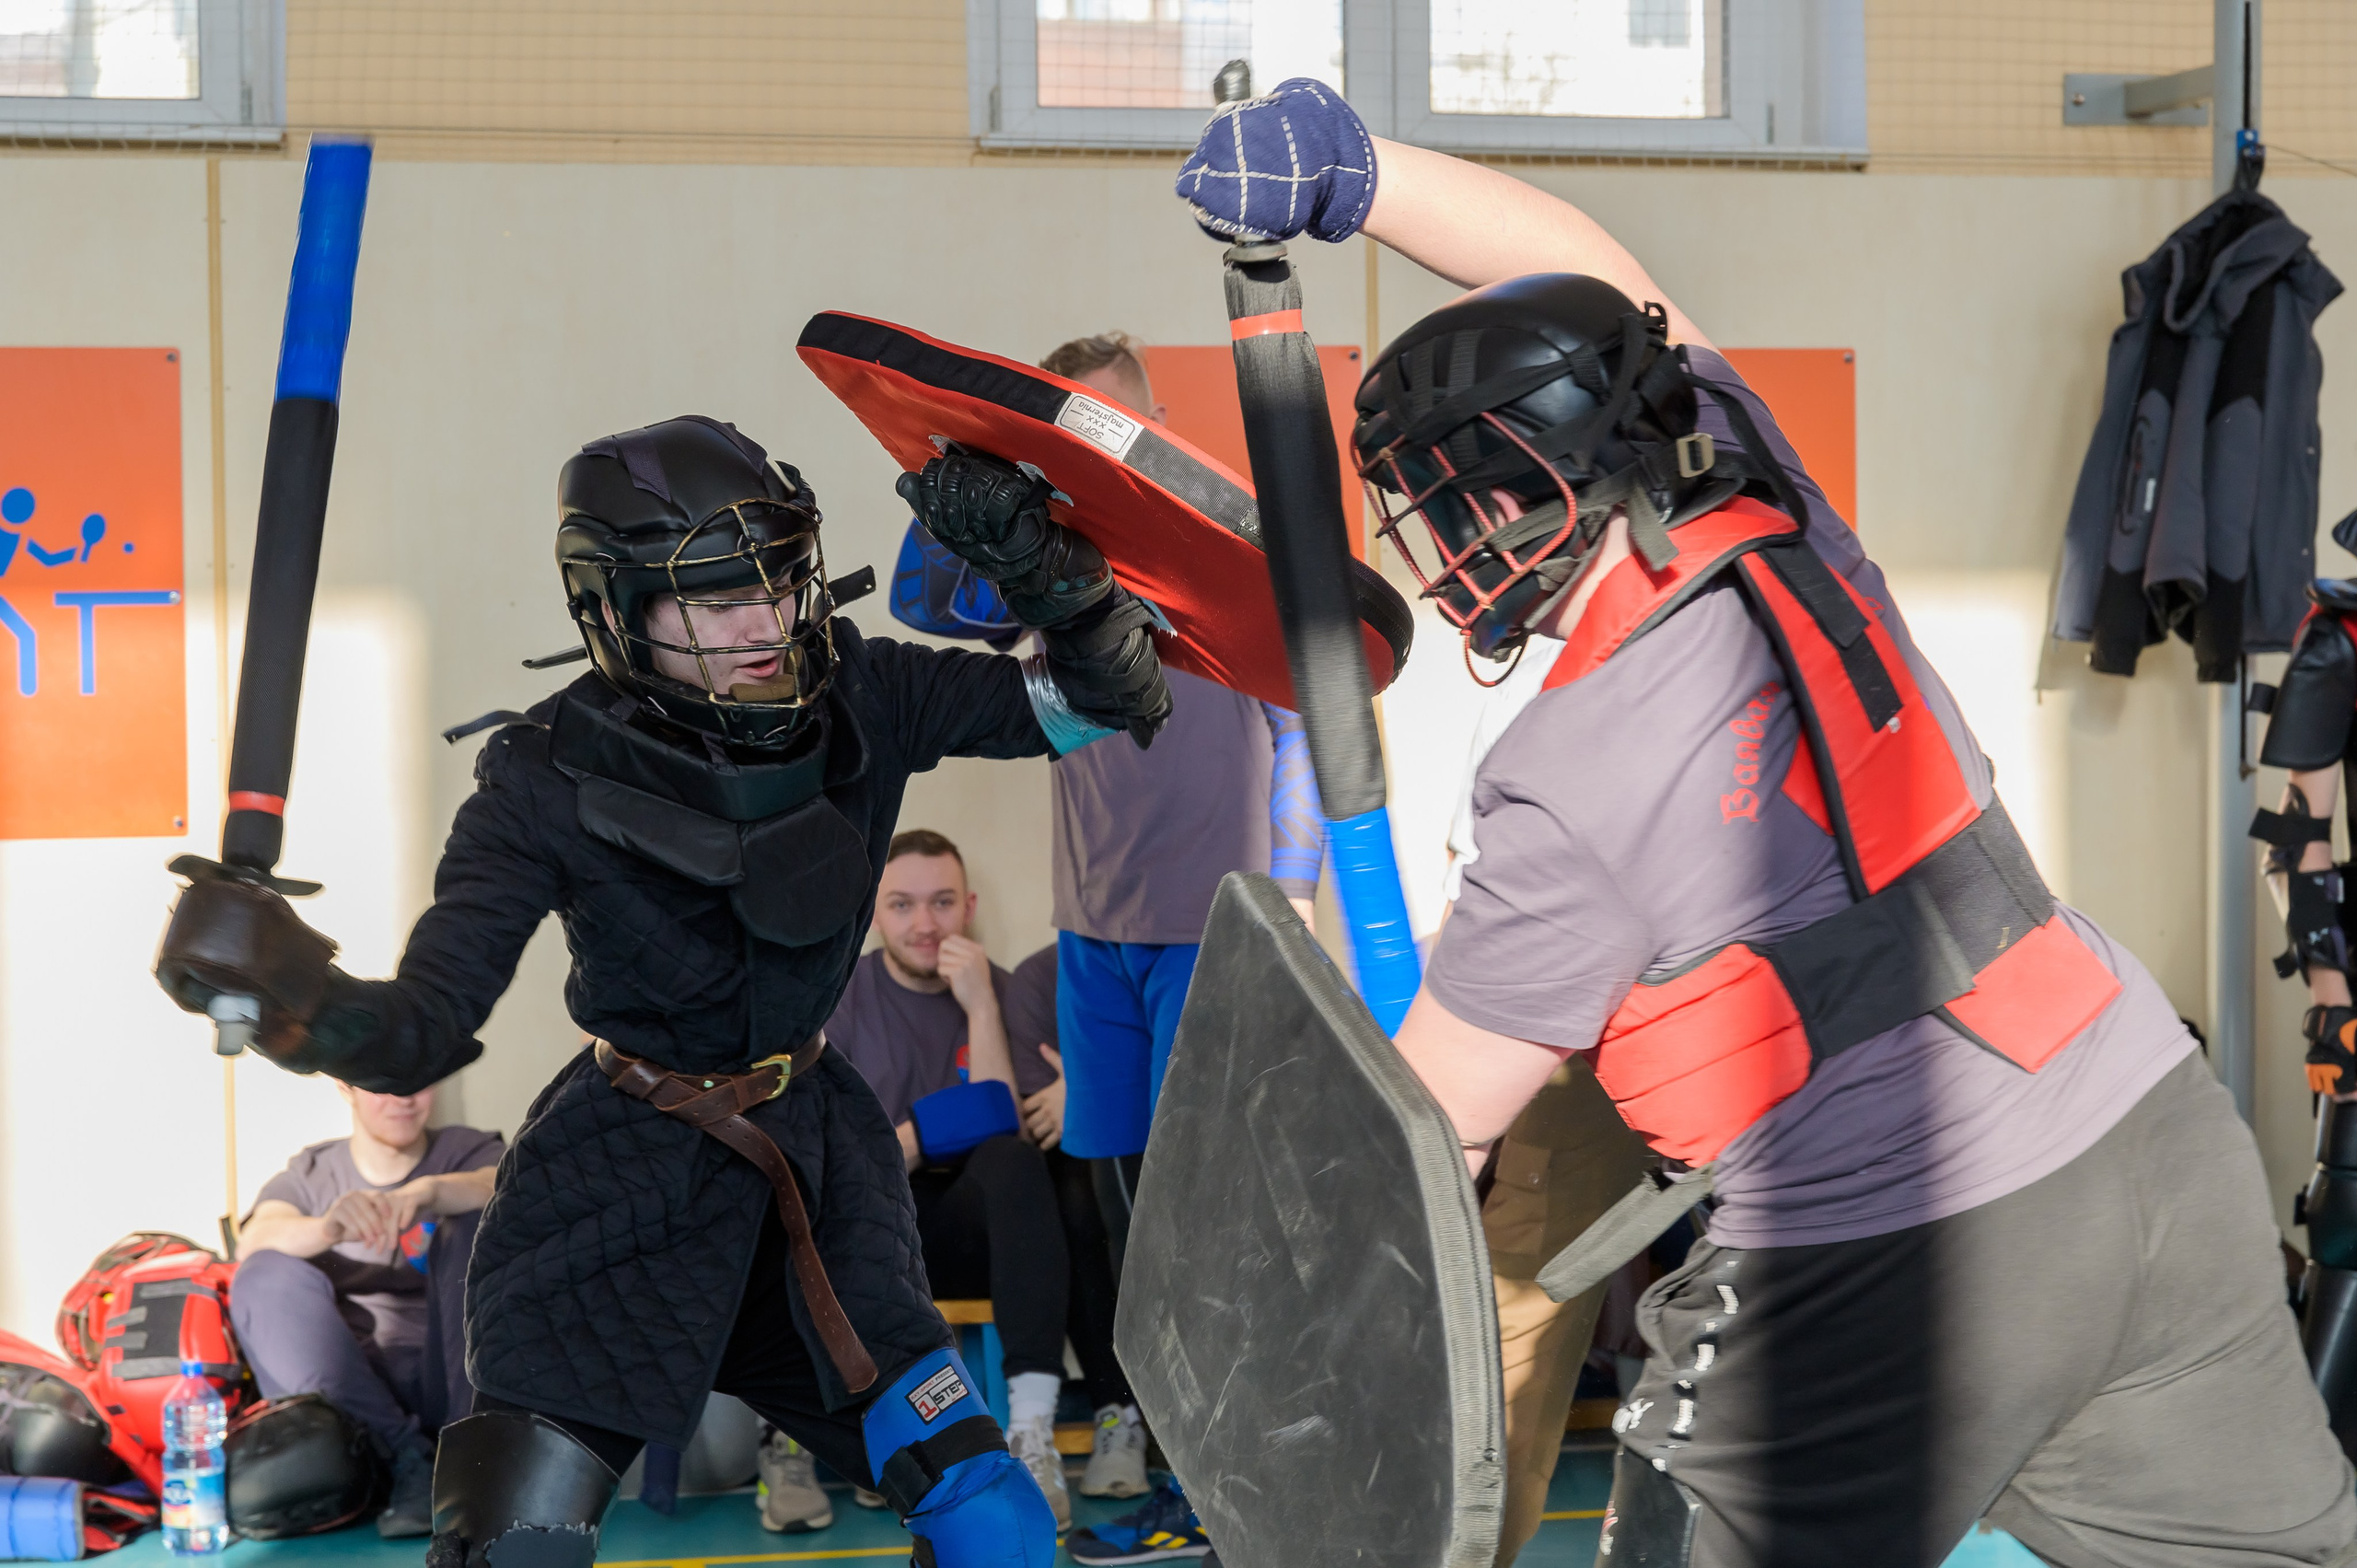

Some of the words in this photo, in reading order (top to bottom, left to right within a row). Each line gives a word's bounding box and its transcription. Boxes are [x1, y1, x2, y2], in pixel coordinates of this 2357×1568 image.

[1078, 401, 1124, 429] majsternia
[1076, 424, 1105, 440] SOFT
[918, 1400, 938, 1419] 1
[933, 1380, 962, 1405] STEP
